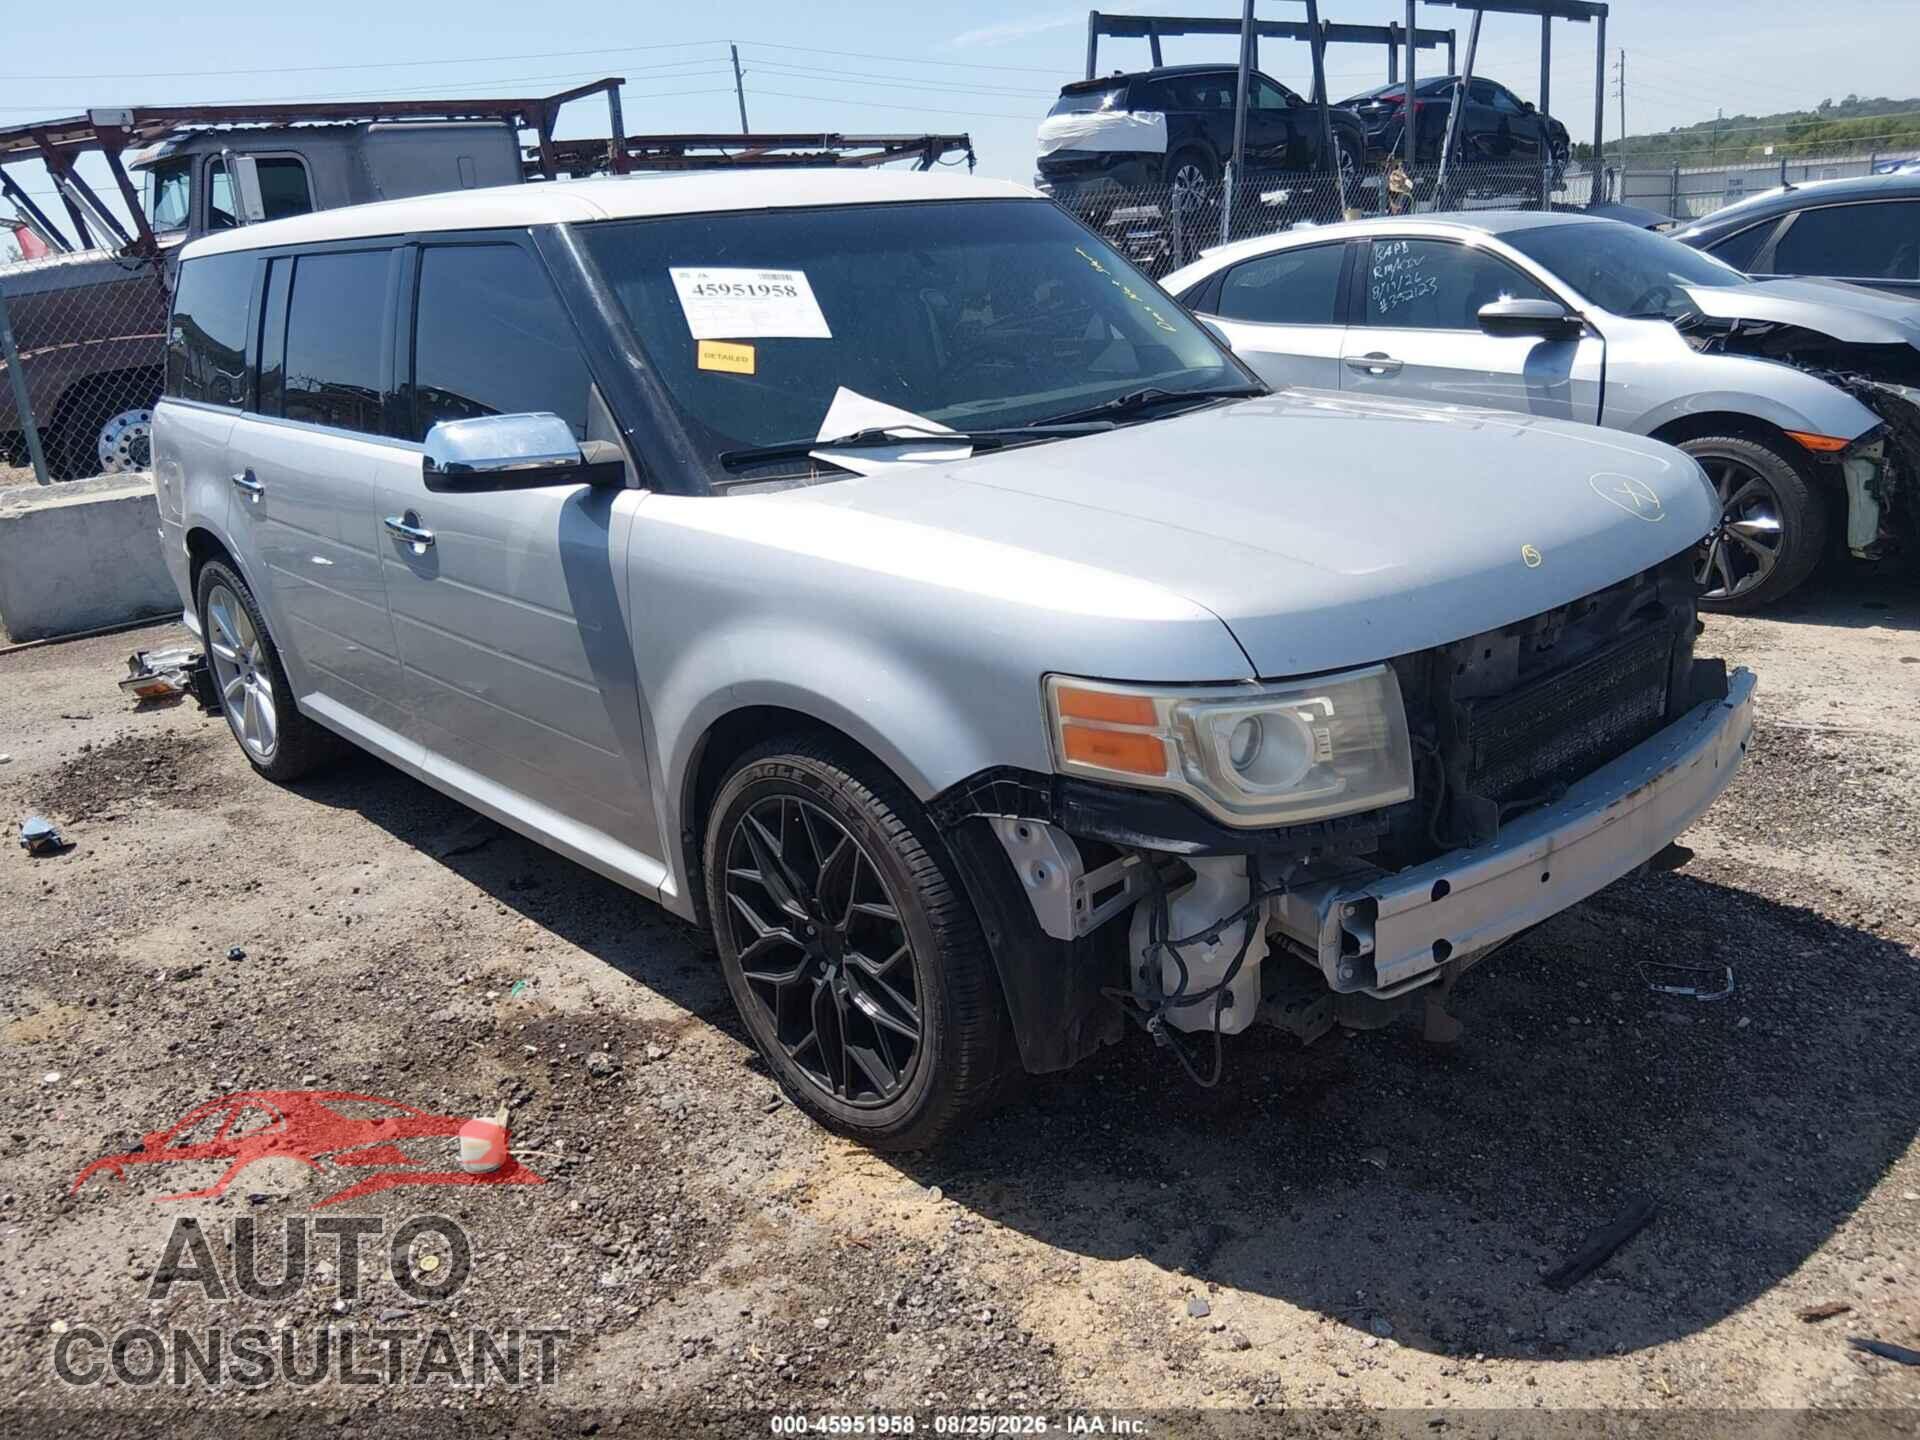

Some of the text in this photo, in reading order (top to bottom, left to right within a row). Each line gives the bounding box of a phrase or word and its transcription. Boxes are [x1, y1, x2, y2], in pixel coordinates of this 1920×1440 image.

[692, 283, 798, 297] 45951958
[703, 352, 749, 364] DETAILED
[742, 765, 803, 783] EAGLE
